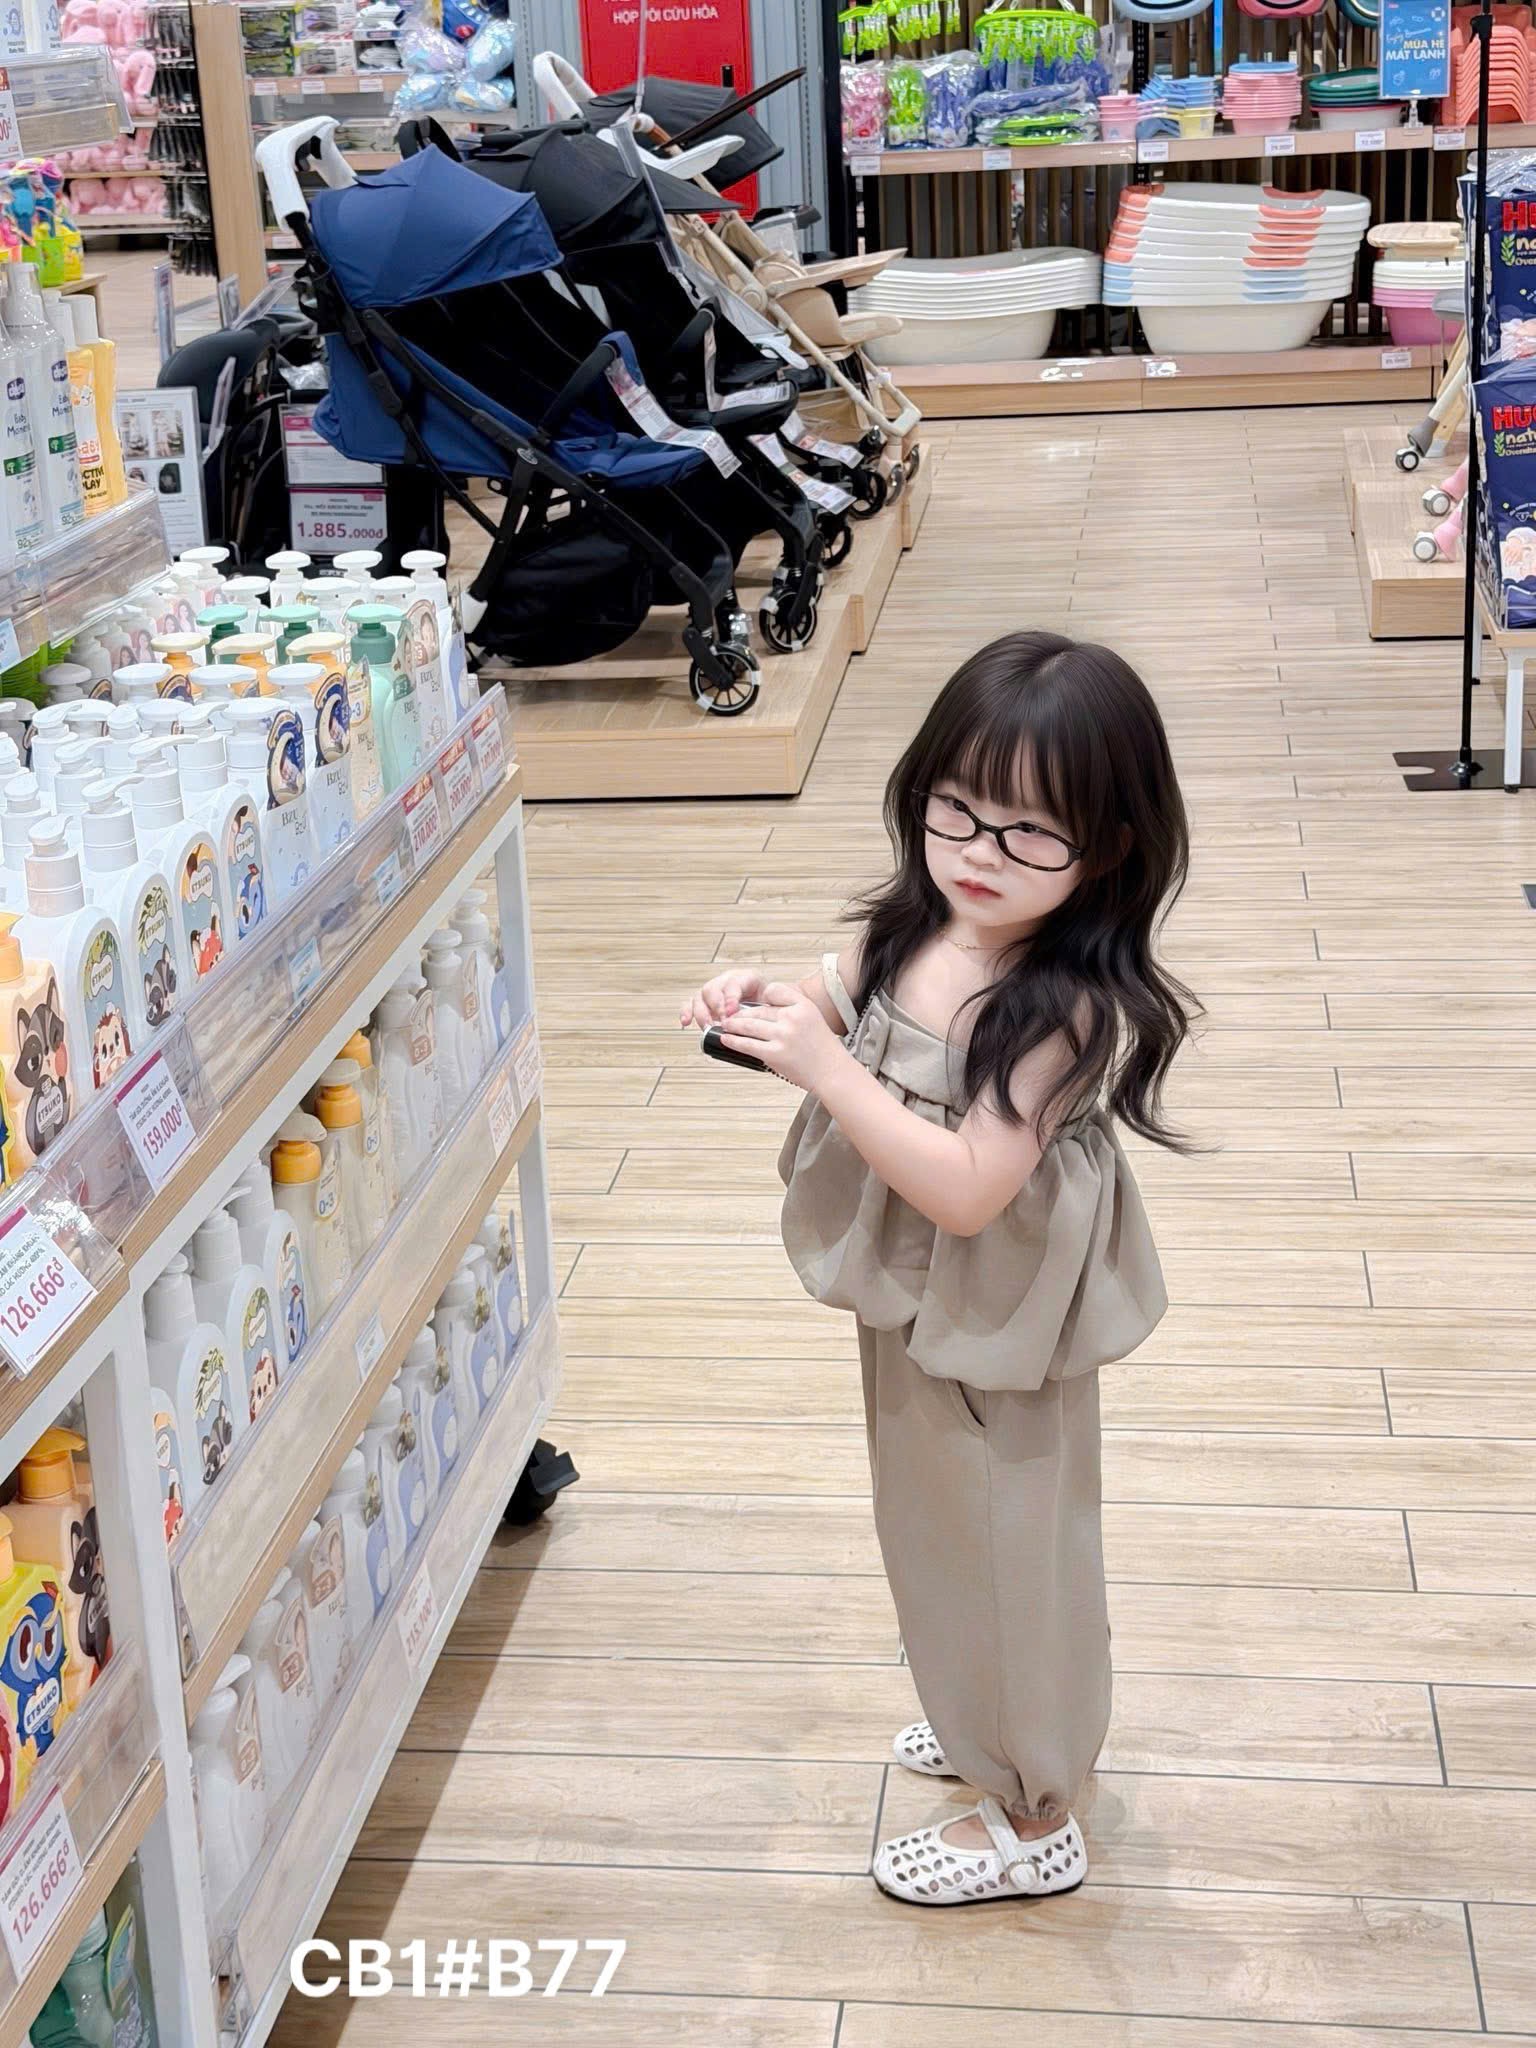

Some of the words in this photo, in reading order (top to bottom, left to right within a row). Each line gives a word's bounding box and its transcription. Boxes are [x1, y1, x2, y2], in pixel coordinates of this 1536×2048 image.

[1492, 404, 1536, 431] HU
[297, 521, 384, 539] 1.885.000đ
[38, 1093, 61, 1123] ETSUKO
[1, 1256, 65, 1338] 126.666đ
[26, 1684, 58, 1727] ETSUKO
[13, 1838, 70, 1943] 126.666đ
